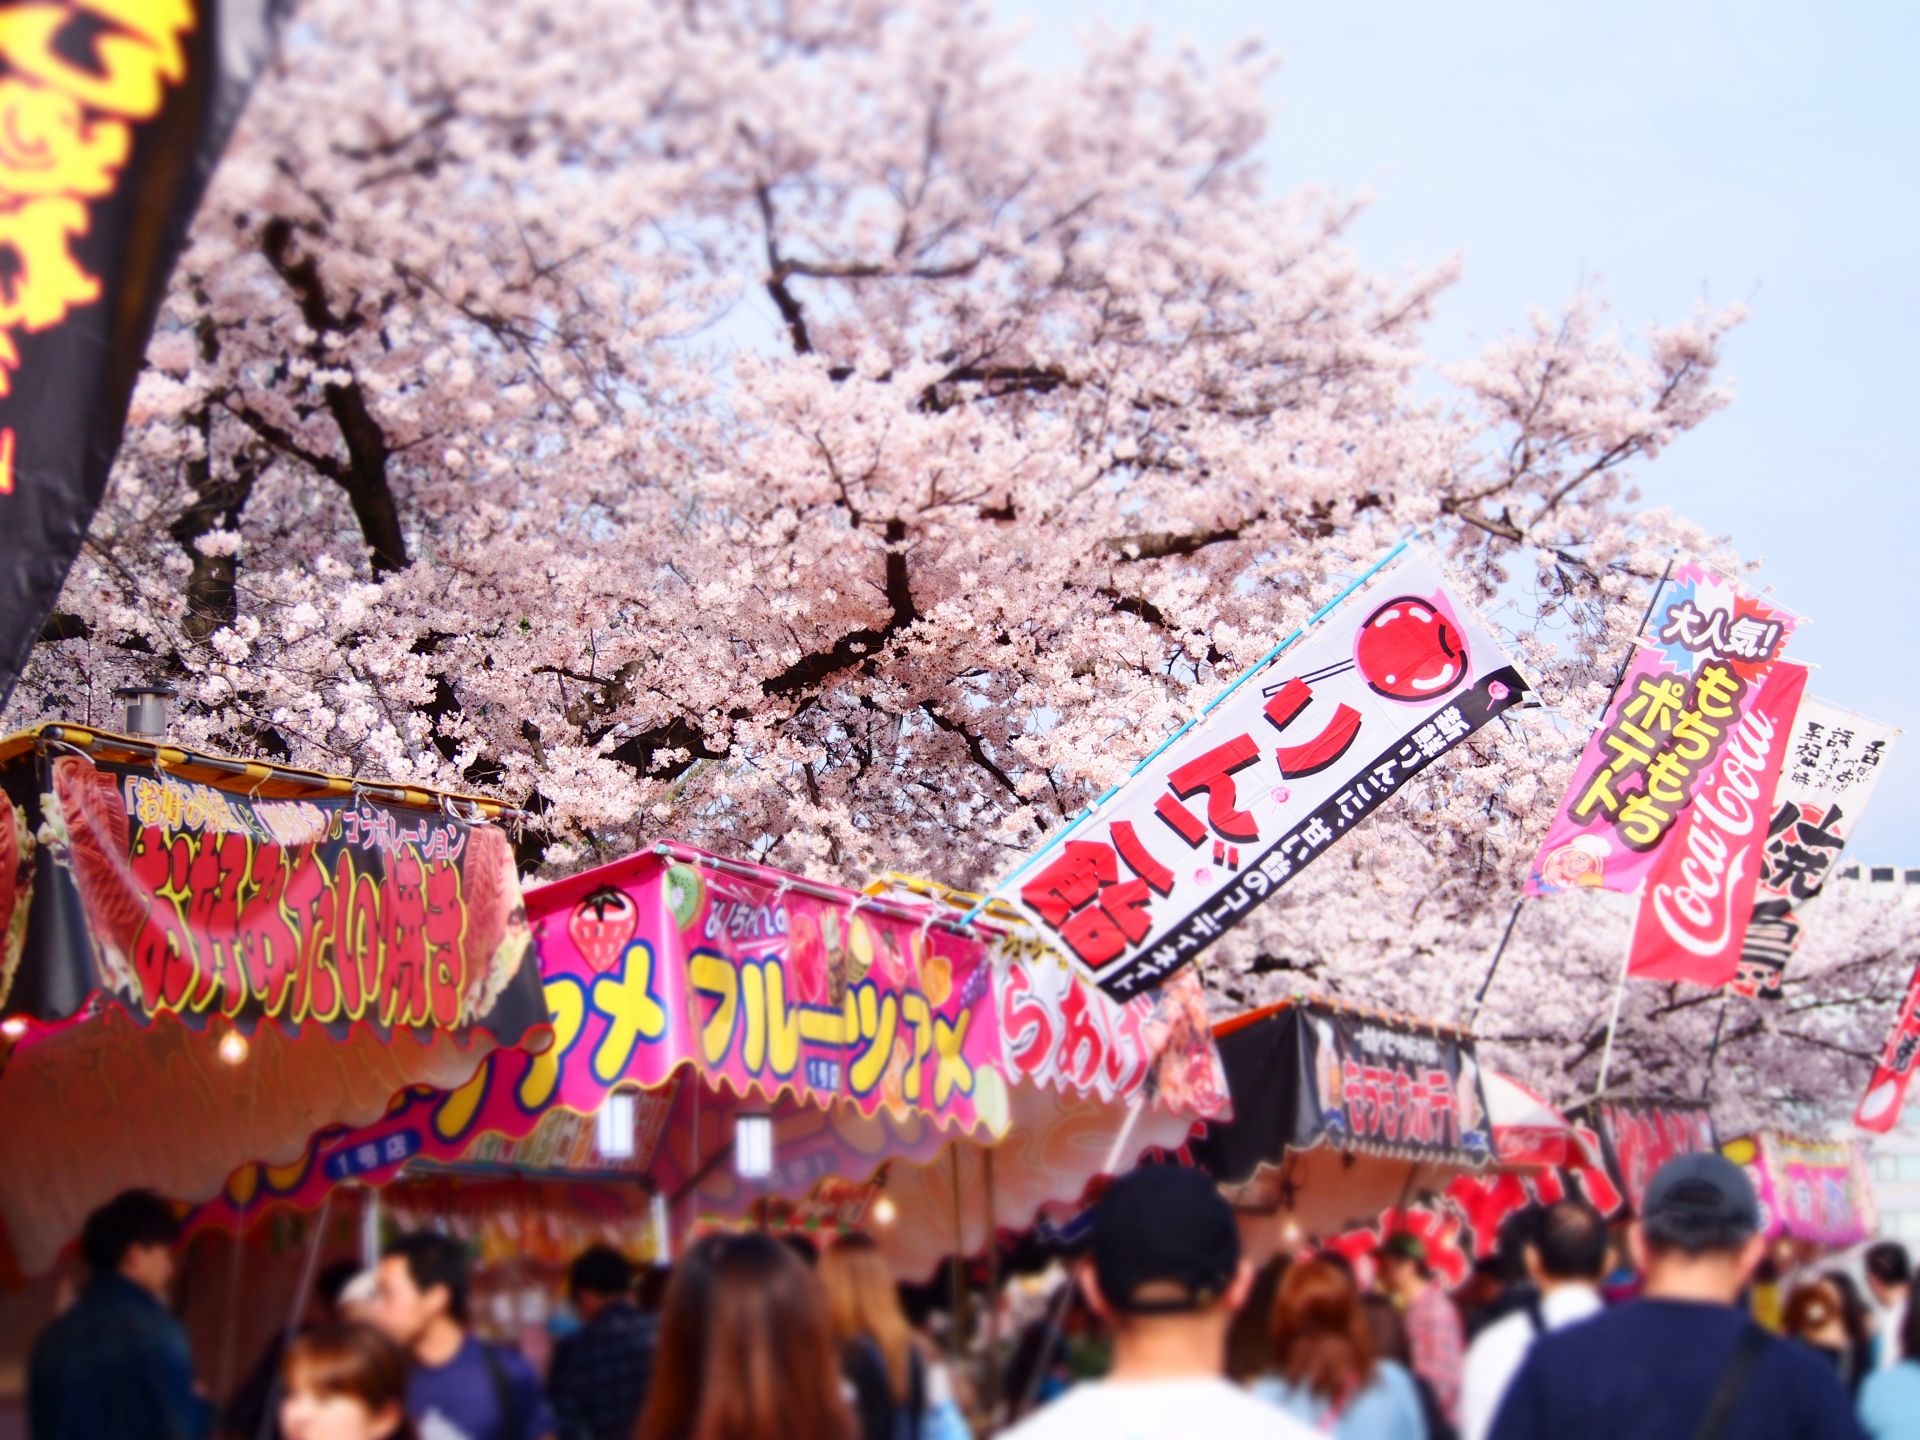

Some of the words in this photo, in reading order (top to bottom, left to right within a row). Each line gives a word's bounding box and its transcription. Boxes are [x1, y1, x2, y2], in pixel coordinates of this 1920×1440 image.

[1663, 605, 1776, 657] 大人気!
[1021, 676, 1362, 972] りんご飴
[1575, 680, 1685, 818] ポテト
[1624, 665, 1740, 845] もちもち
[687, 946, 976, 1110] フルーツアメ
